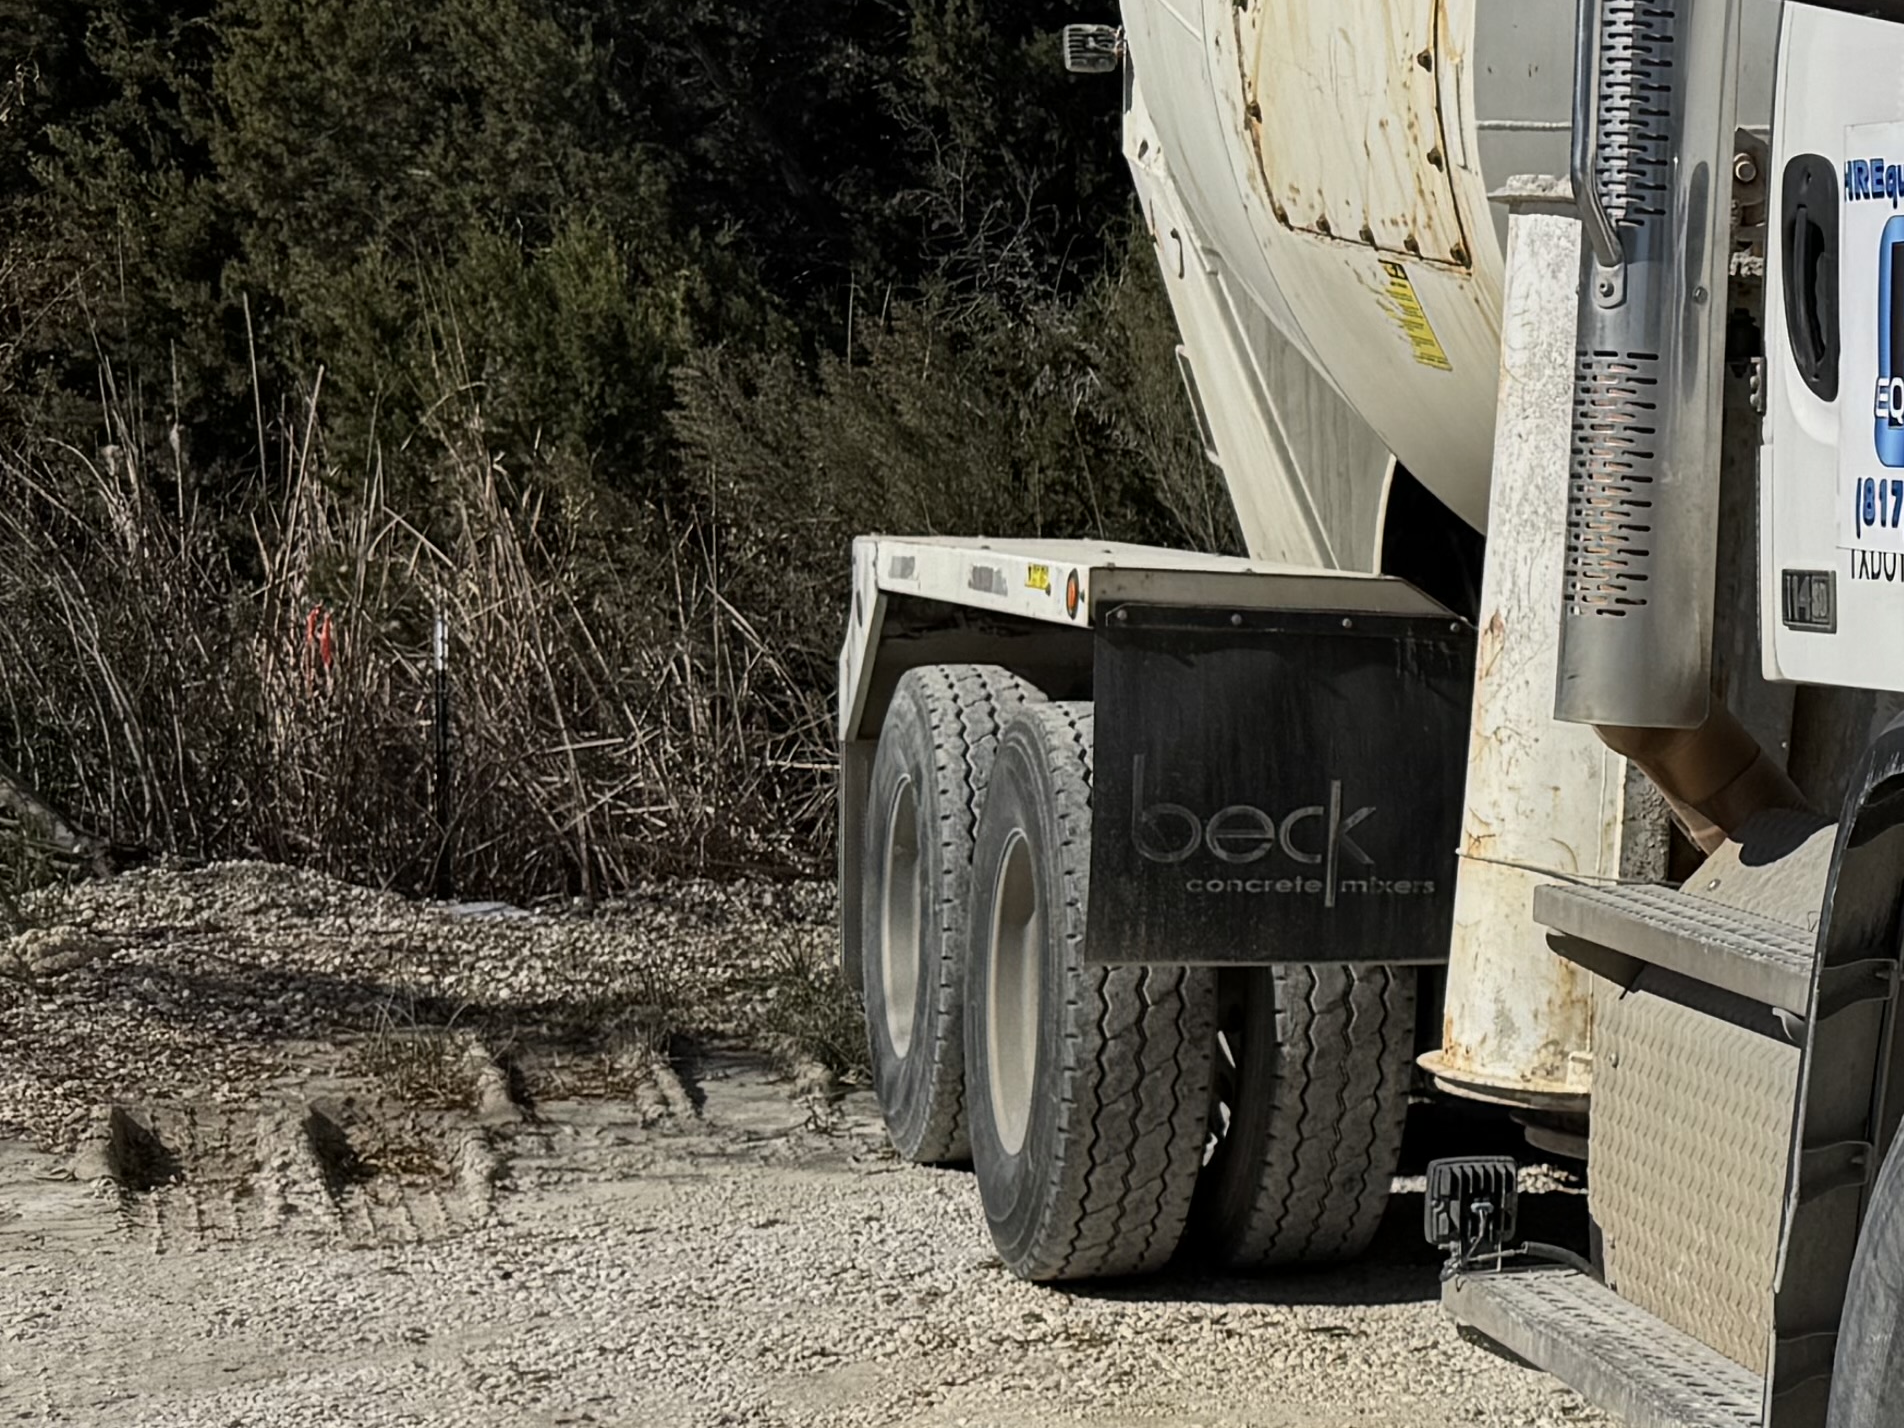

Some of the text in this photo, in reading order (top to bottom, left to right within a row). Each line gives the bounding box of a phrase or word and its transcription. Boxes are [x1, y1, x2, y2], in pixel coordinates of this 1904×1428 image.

[1131, 754, 1377, 908] beck
[1186, 875, 1435, 895] concrete mixers
